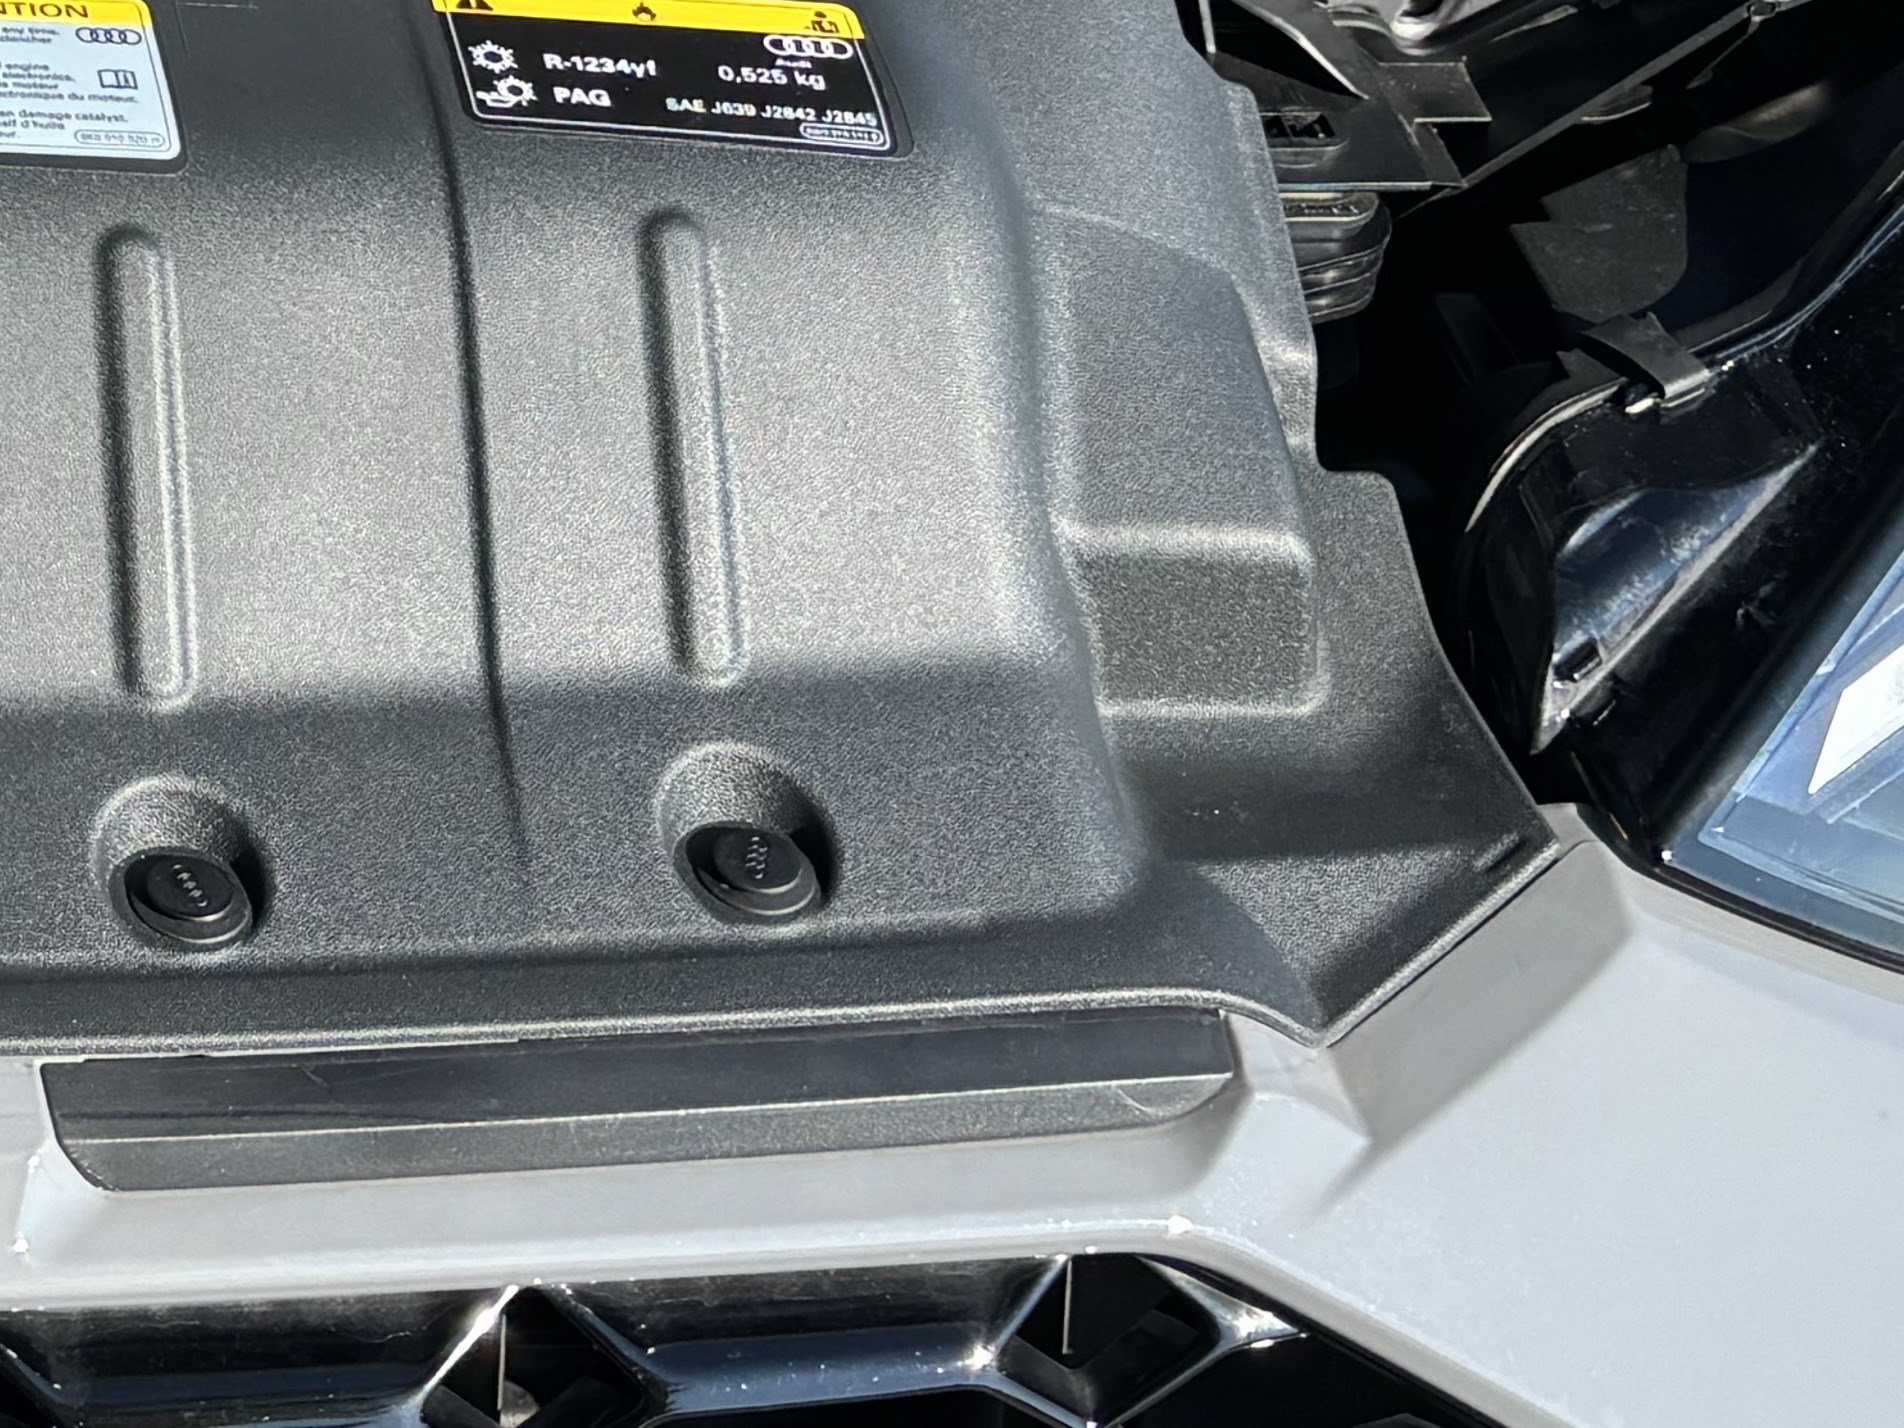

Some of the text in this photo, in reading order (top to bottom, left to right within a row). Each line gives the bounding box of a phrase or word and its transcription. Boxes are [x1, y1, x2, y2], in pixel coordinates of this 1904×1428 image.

[542, 53, 657, 78] R-1234yf
[718, 65, 826, 90] 0,525 kg
[553, 86, 611, 107] PAG
[665, 97, 878, 126] SAE J639 J2842 J2845
